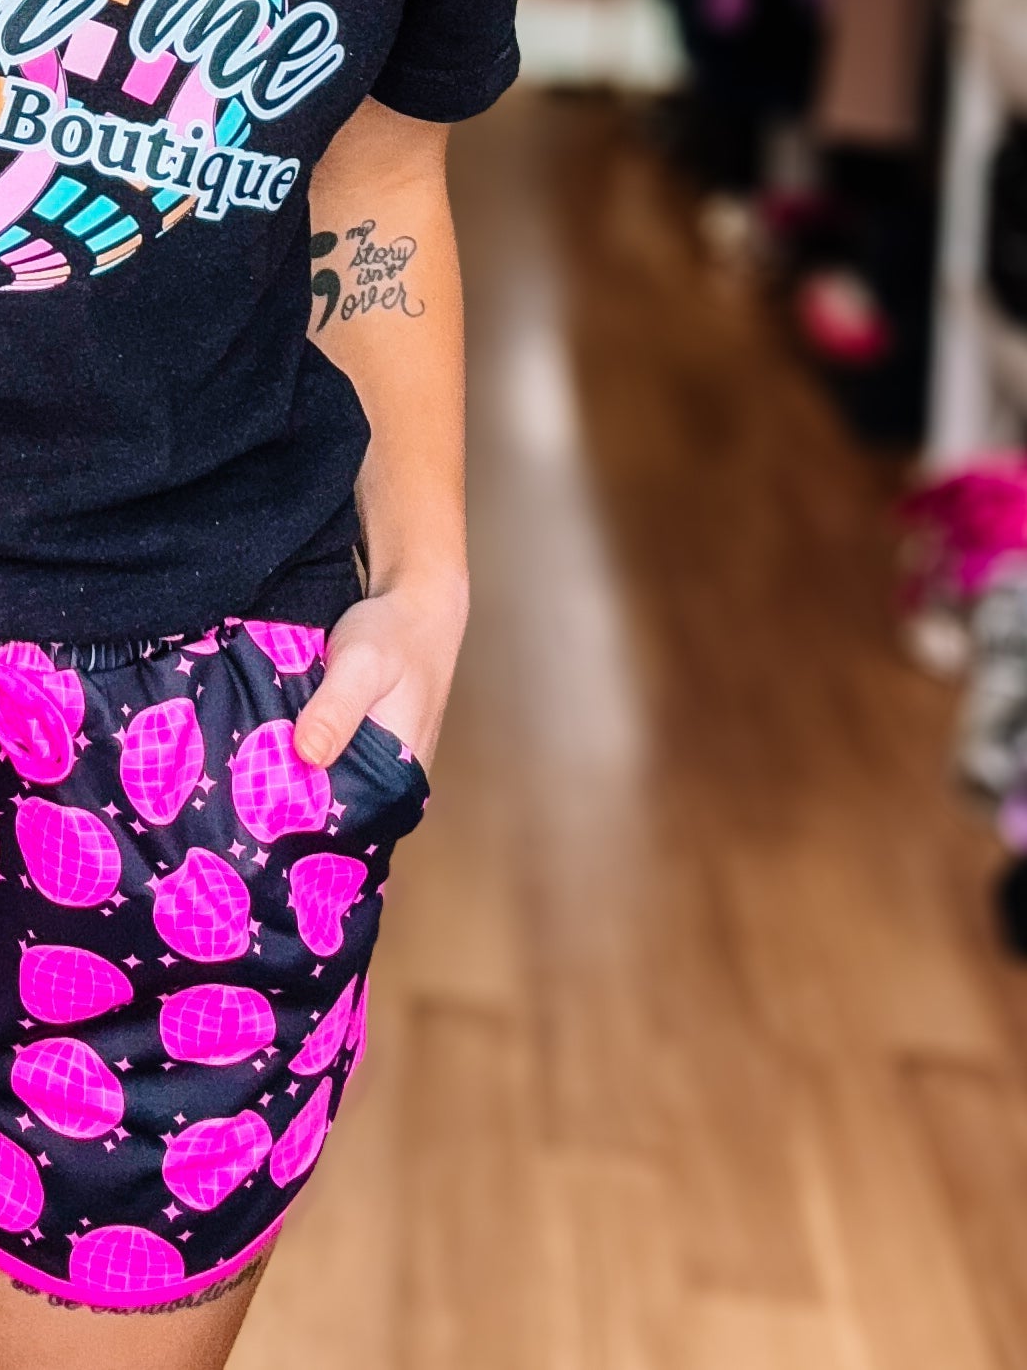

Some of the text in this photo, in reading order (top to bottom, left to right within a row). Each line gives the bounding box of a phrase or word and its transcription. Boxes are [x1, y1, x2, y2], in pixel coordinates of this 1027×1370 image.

[345, 219, 376, 244] my
[348, 235, 417, 271] story
[340, 281, 425, 320] over
